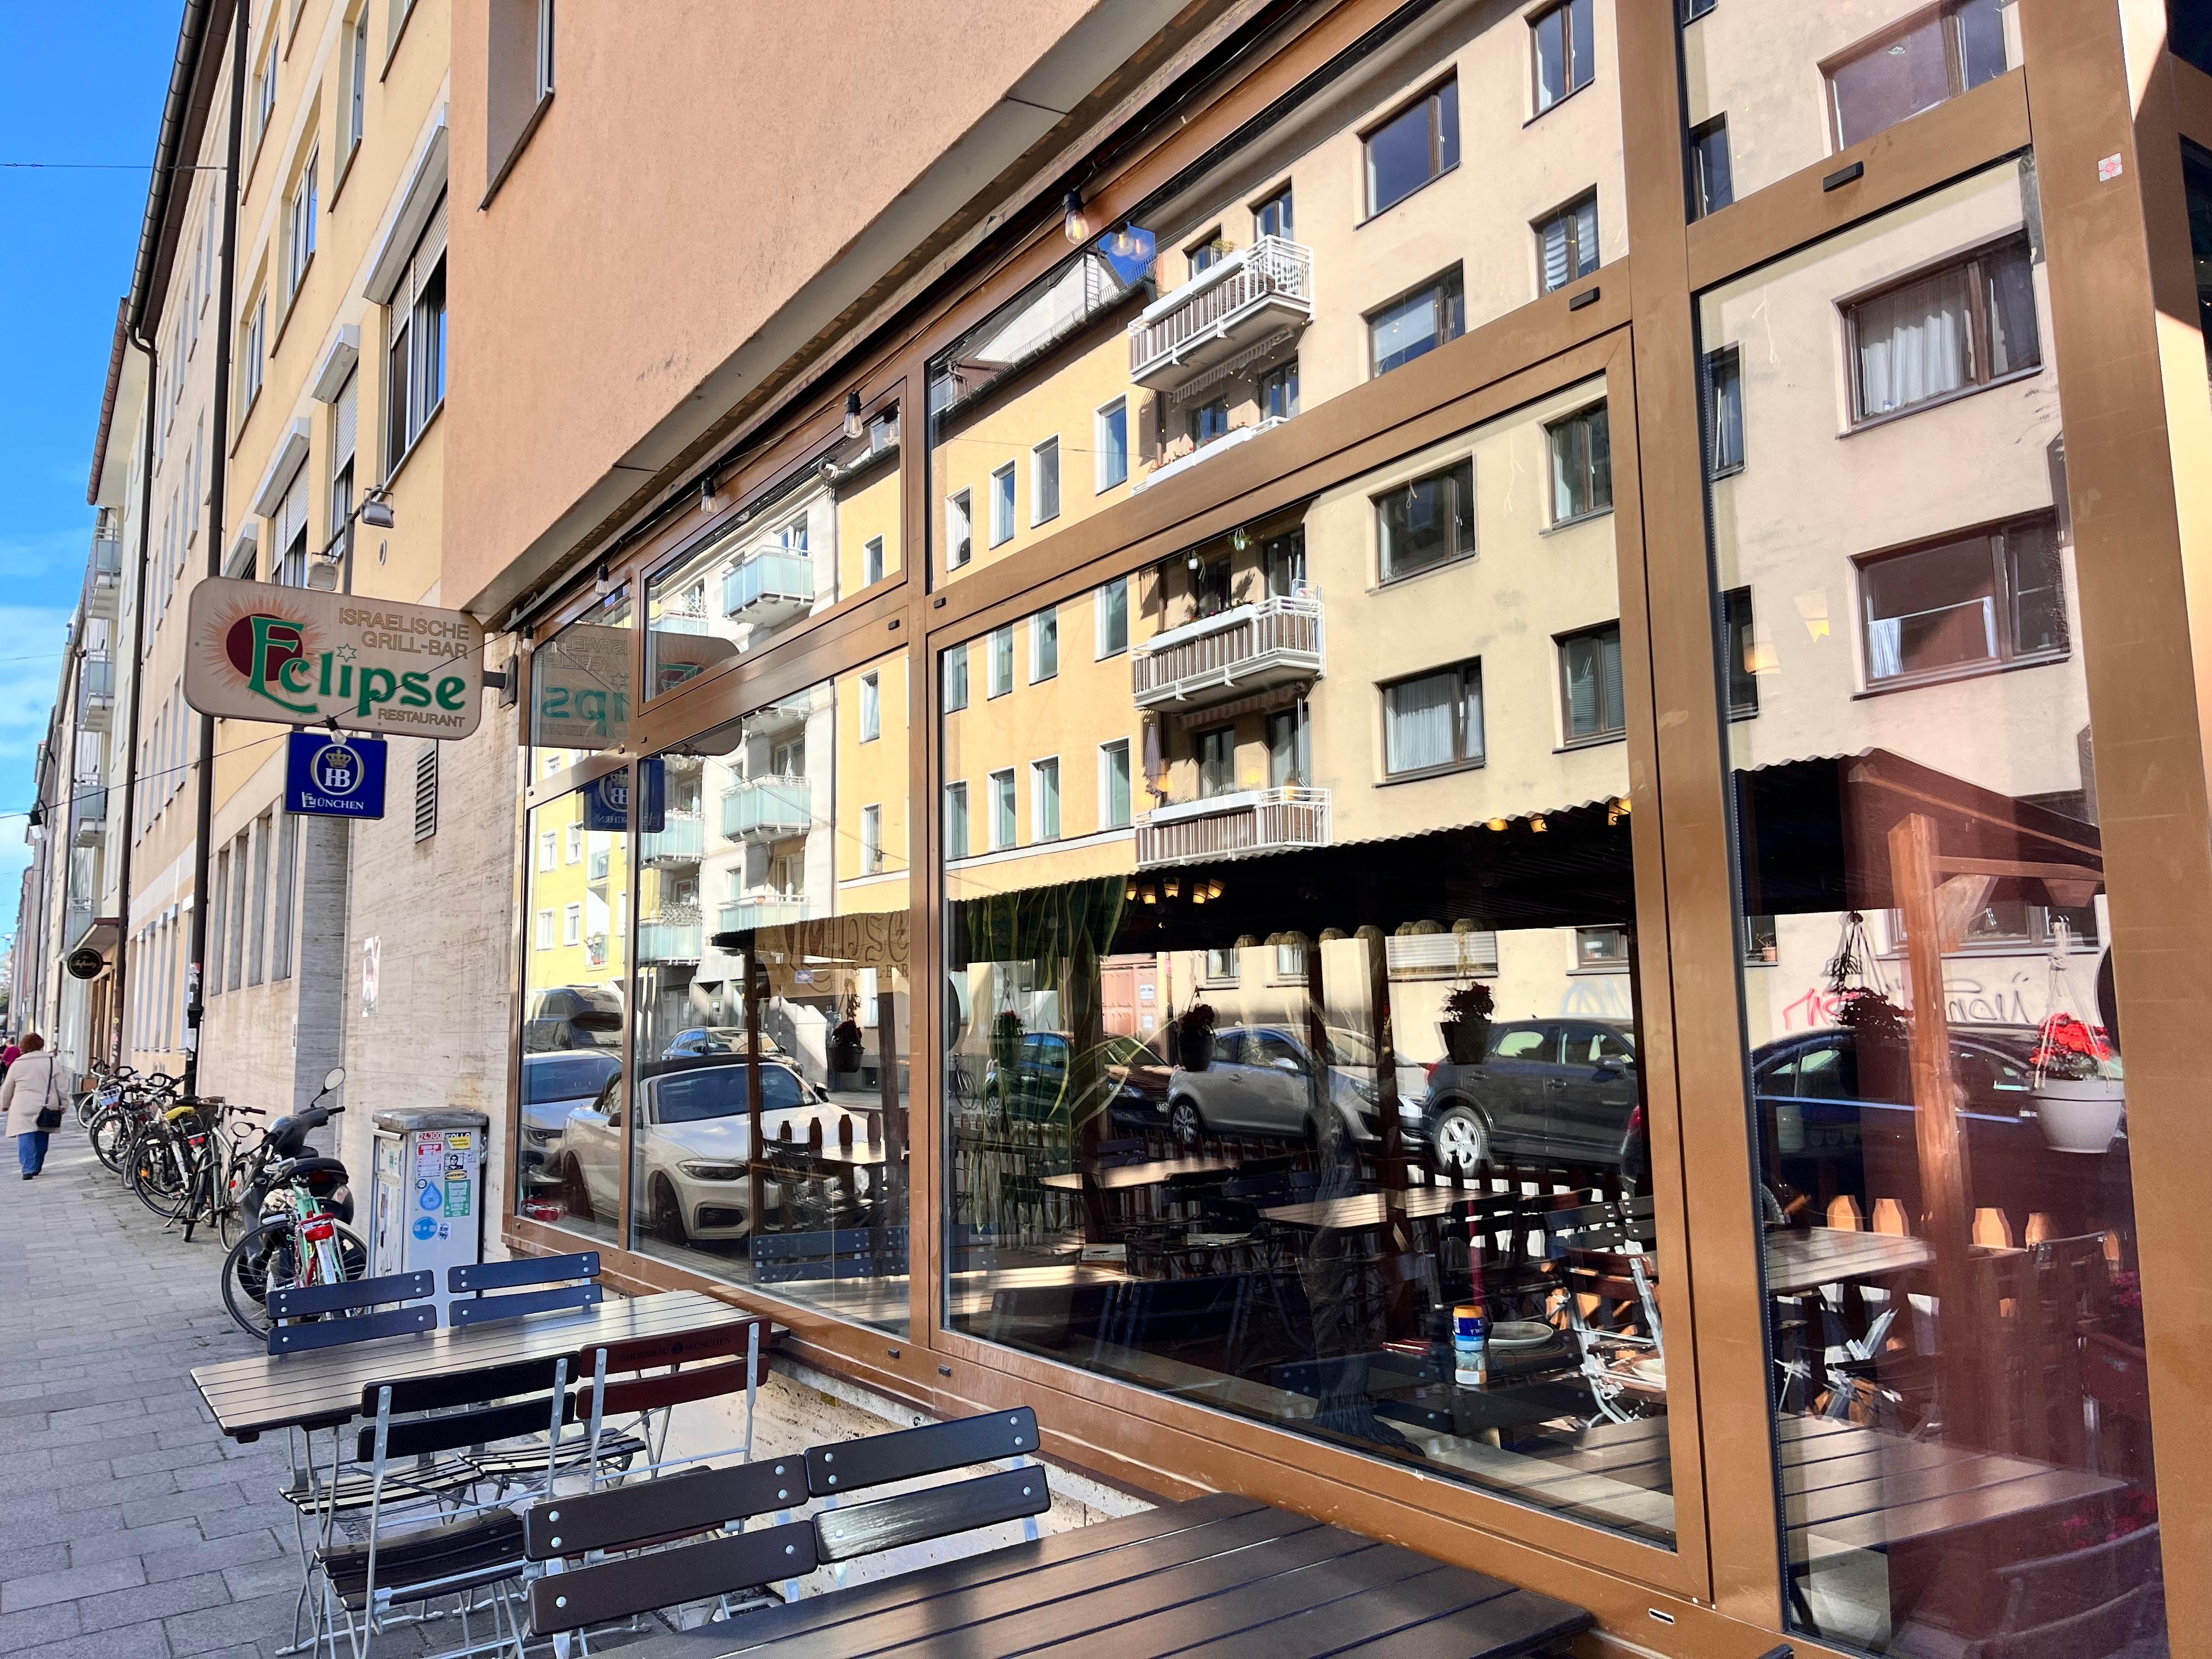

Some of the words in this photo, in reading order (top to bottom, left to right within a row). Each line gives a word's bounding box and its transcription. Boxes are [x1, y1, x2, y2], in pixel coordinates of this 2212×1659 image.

[338, 607, 470, 640] ISRAELISCHE
[362, 631, 468, 659] GRILL-BAR
[247, 615, 466, 718] Eclipse
[378, 708, 465, 727] RESTAURANT
[325, 768, 351, 787] HB
